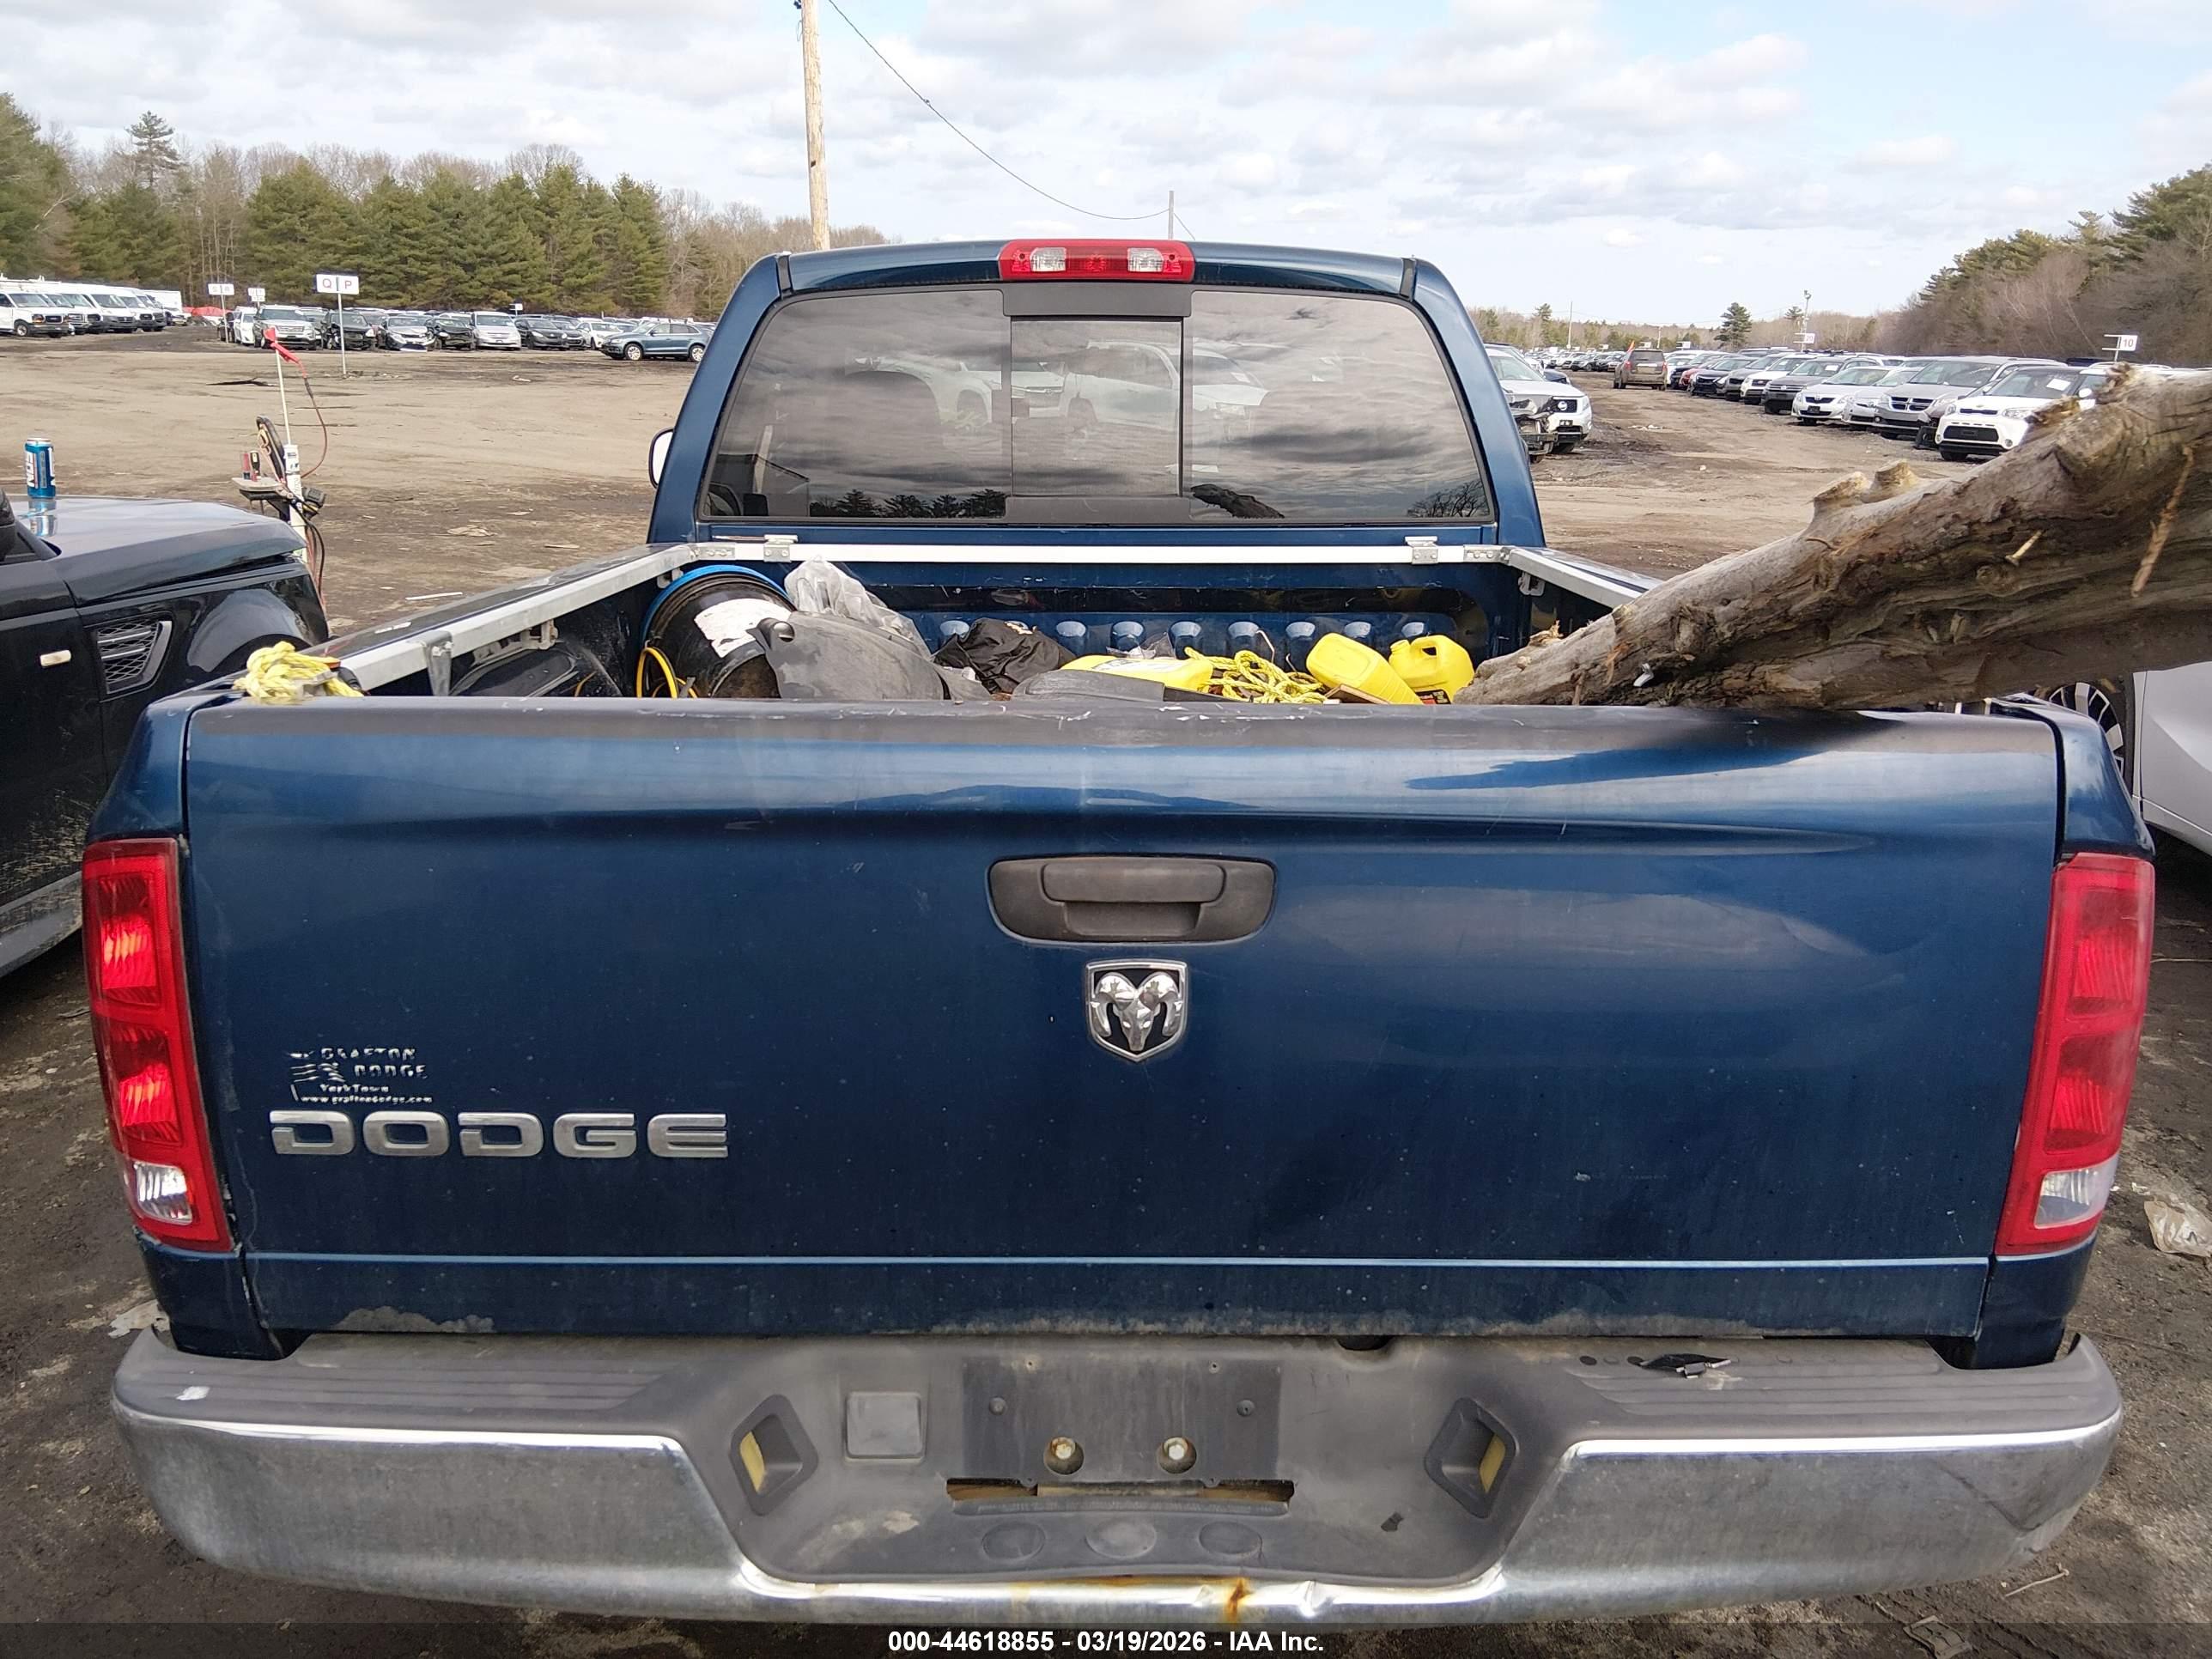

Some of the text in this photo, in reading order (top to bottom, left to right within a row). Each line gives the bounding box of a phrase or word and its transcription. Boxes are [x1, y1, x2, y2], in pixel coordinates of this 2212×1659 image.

[322, 278, 352, 289] Q P
[2123, 338, 2134, 348] 10
[269, 1110, 728, 1158] DODGE
